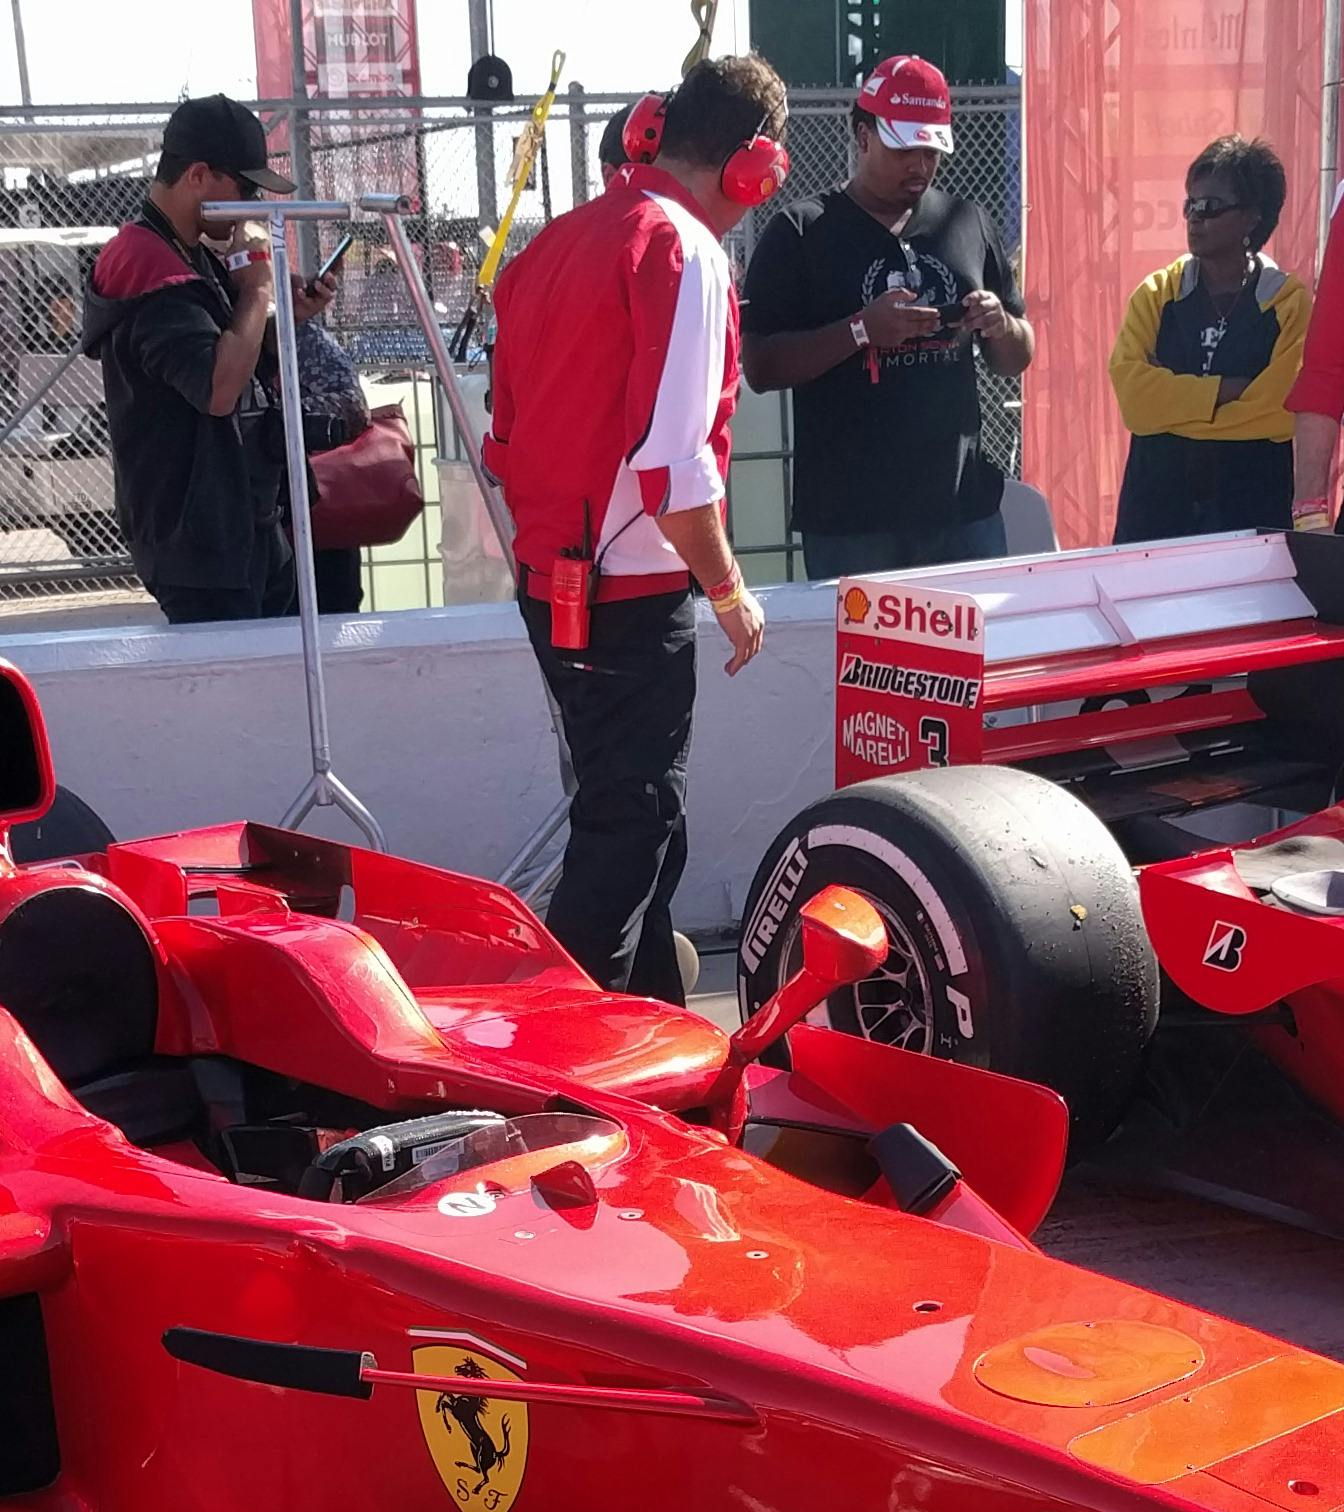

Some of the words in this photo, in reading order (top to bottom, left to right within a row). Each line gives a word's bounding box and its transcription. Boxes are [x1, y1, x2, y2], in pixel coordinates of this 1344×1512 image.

[327, 32, 388, 47] HUBLOT
[877, 594, 977, 642] Shell
[840, 656, 981, 708] BRIDGESTONE
[843, 711, 910, 745] MAGNETI
[843, 735, 910, 767] MARELLI
[740, 837, 809, 975] PIRELLI
[456, 1477, 471, 1503] S
